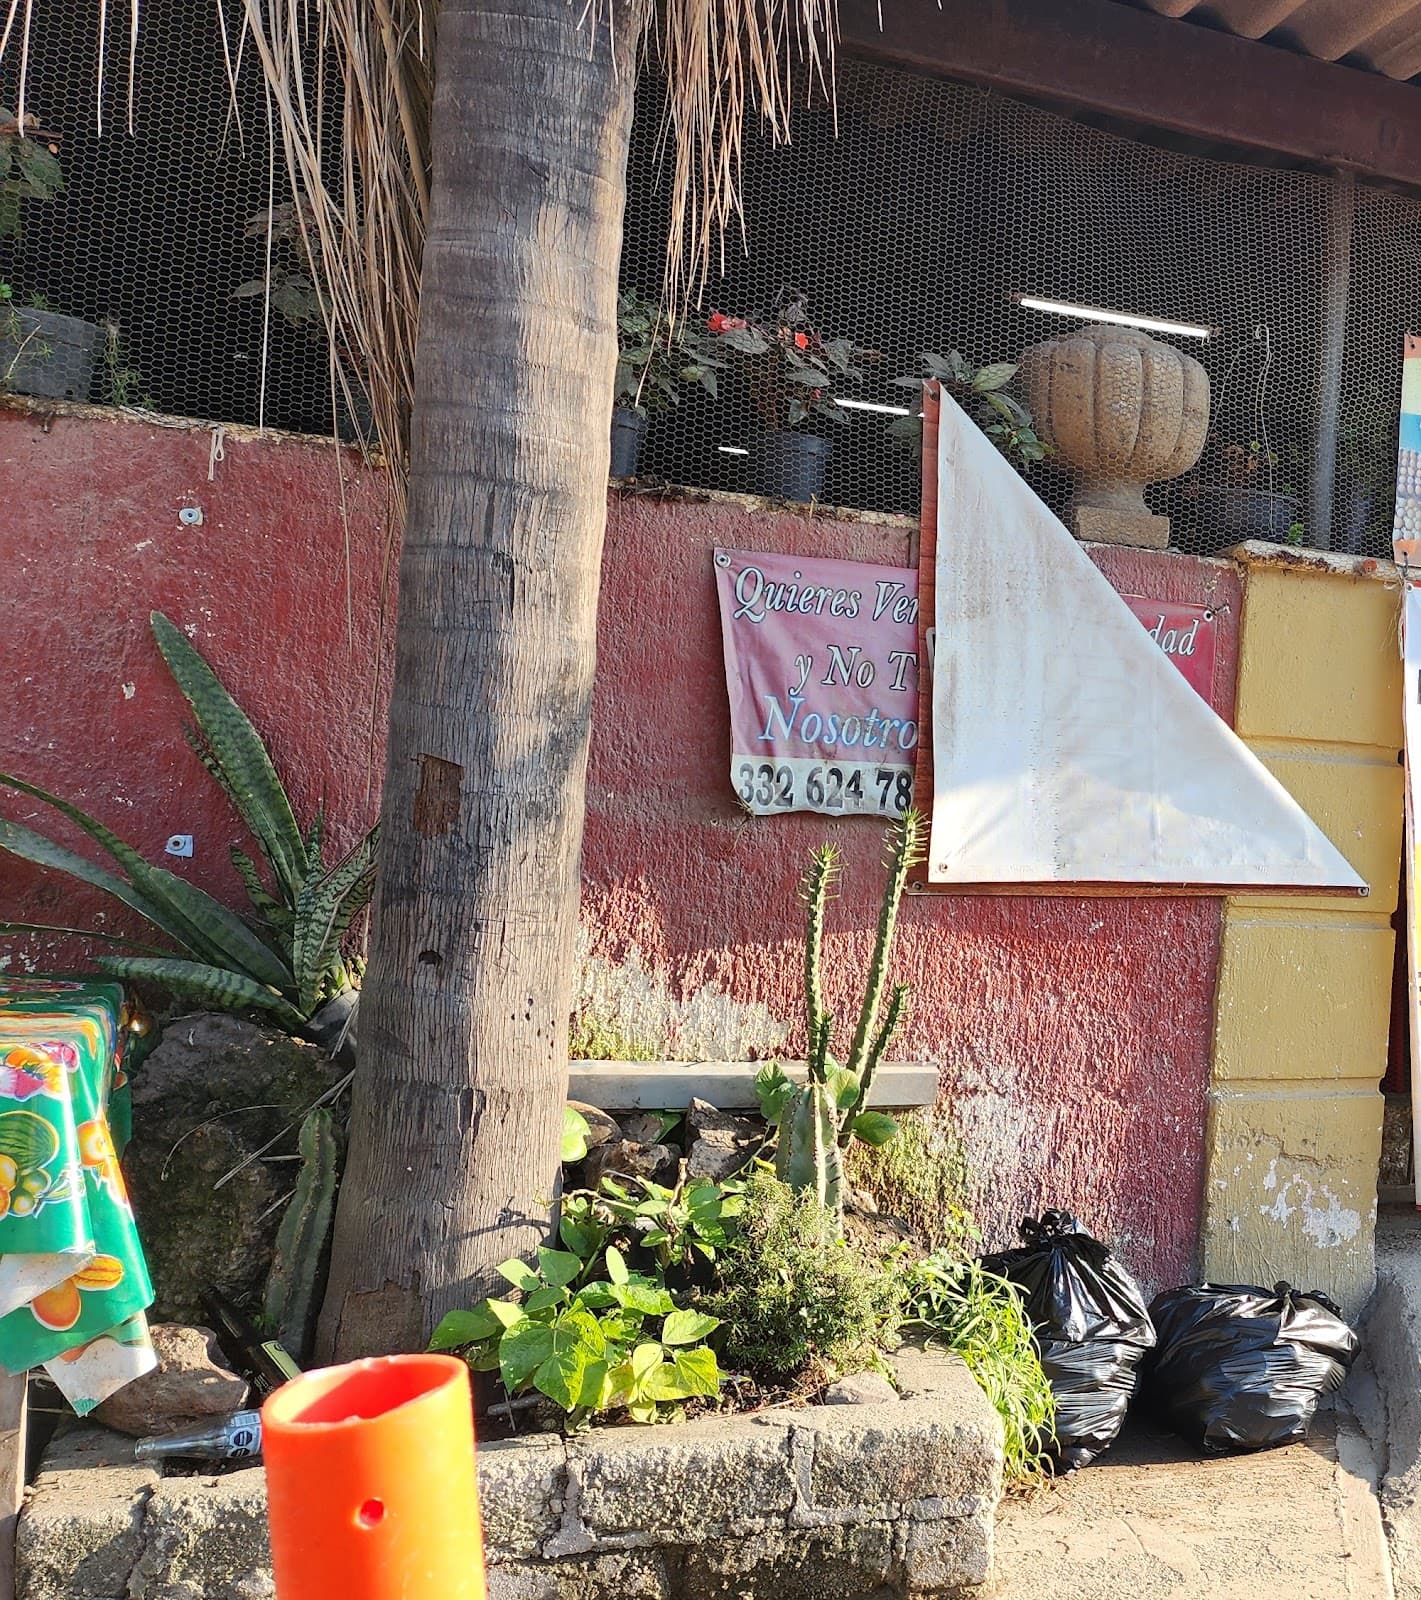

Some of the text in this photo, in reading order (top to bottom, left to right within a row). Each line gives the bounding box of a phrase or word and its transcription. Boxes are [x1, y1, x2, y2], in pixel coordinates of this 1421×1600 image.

[733, 567, 862, 623] Quieres
[788, 653, 813, 695] y
[821, 645, 876, 688] No
[739, 763, 794, 808] 332
[806, 766, 863, 809] 624
